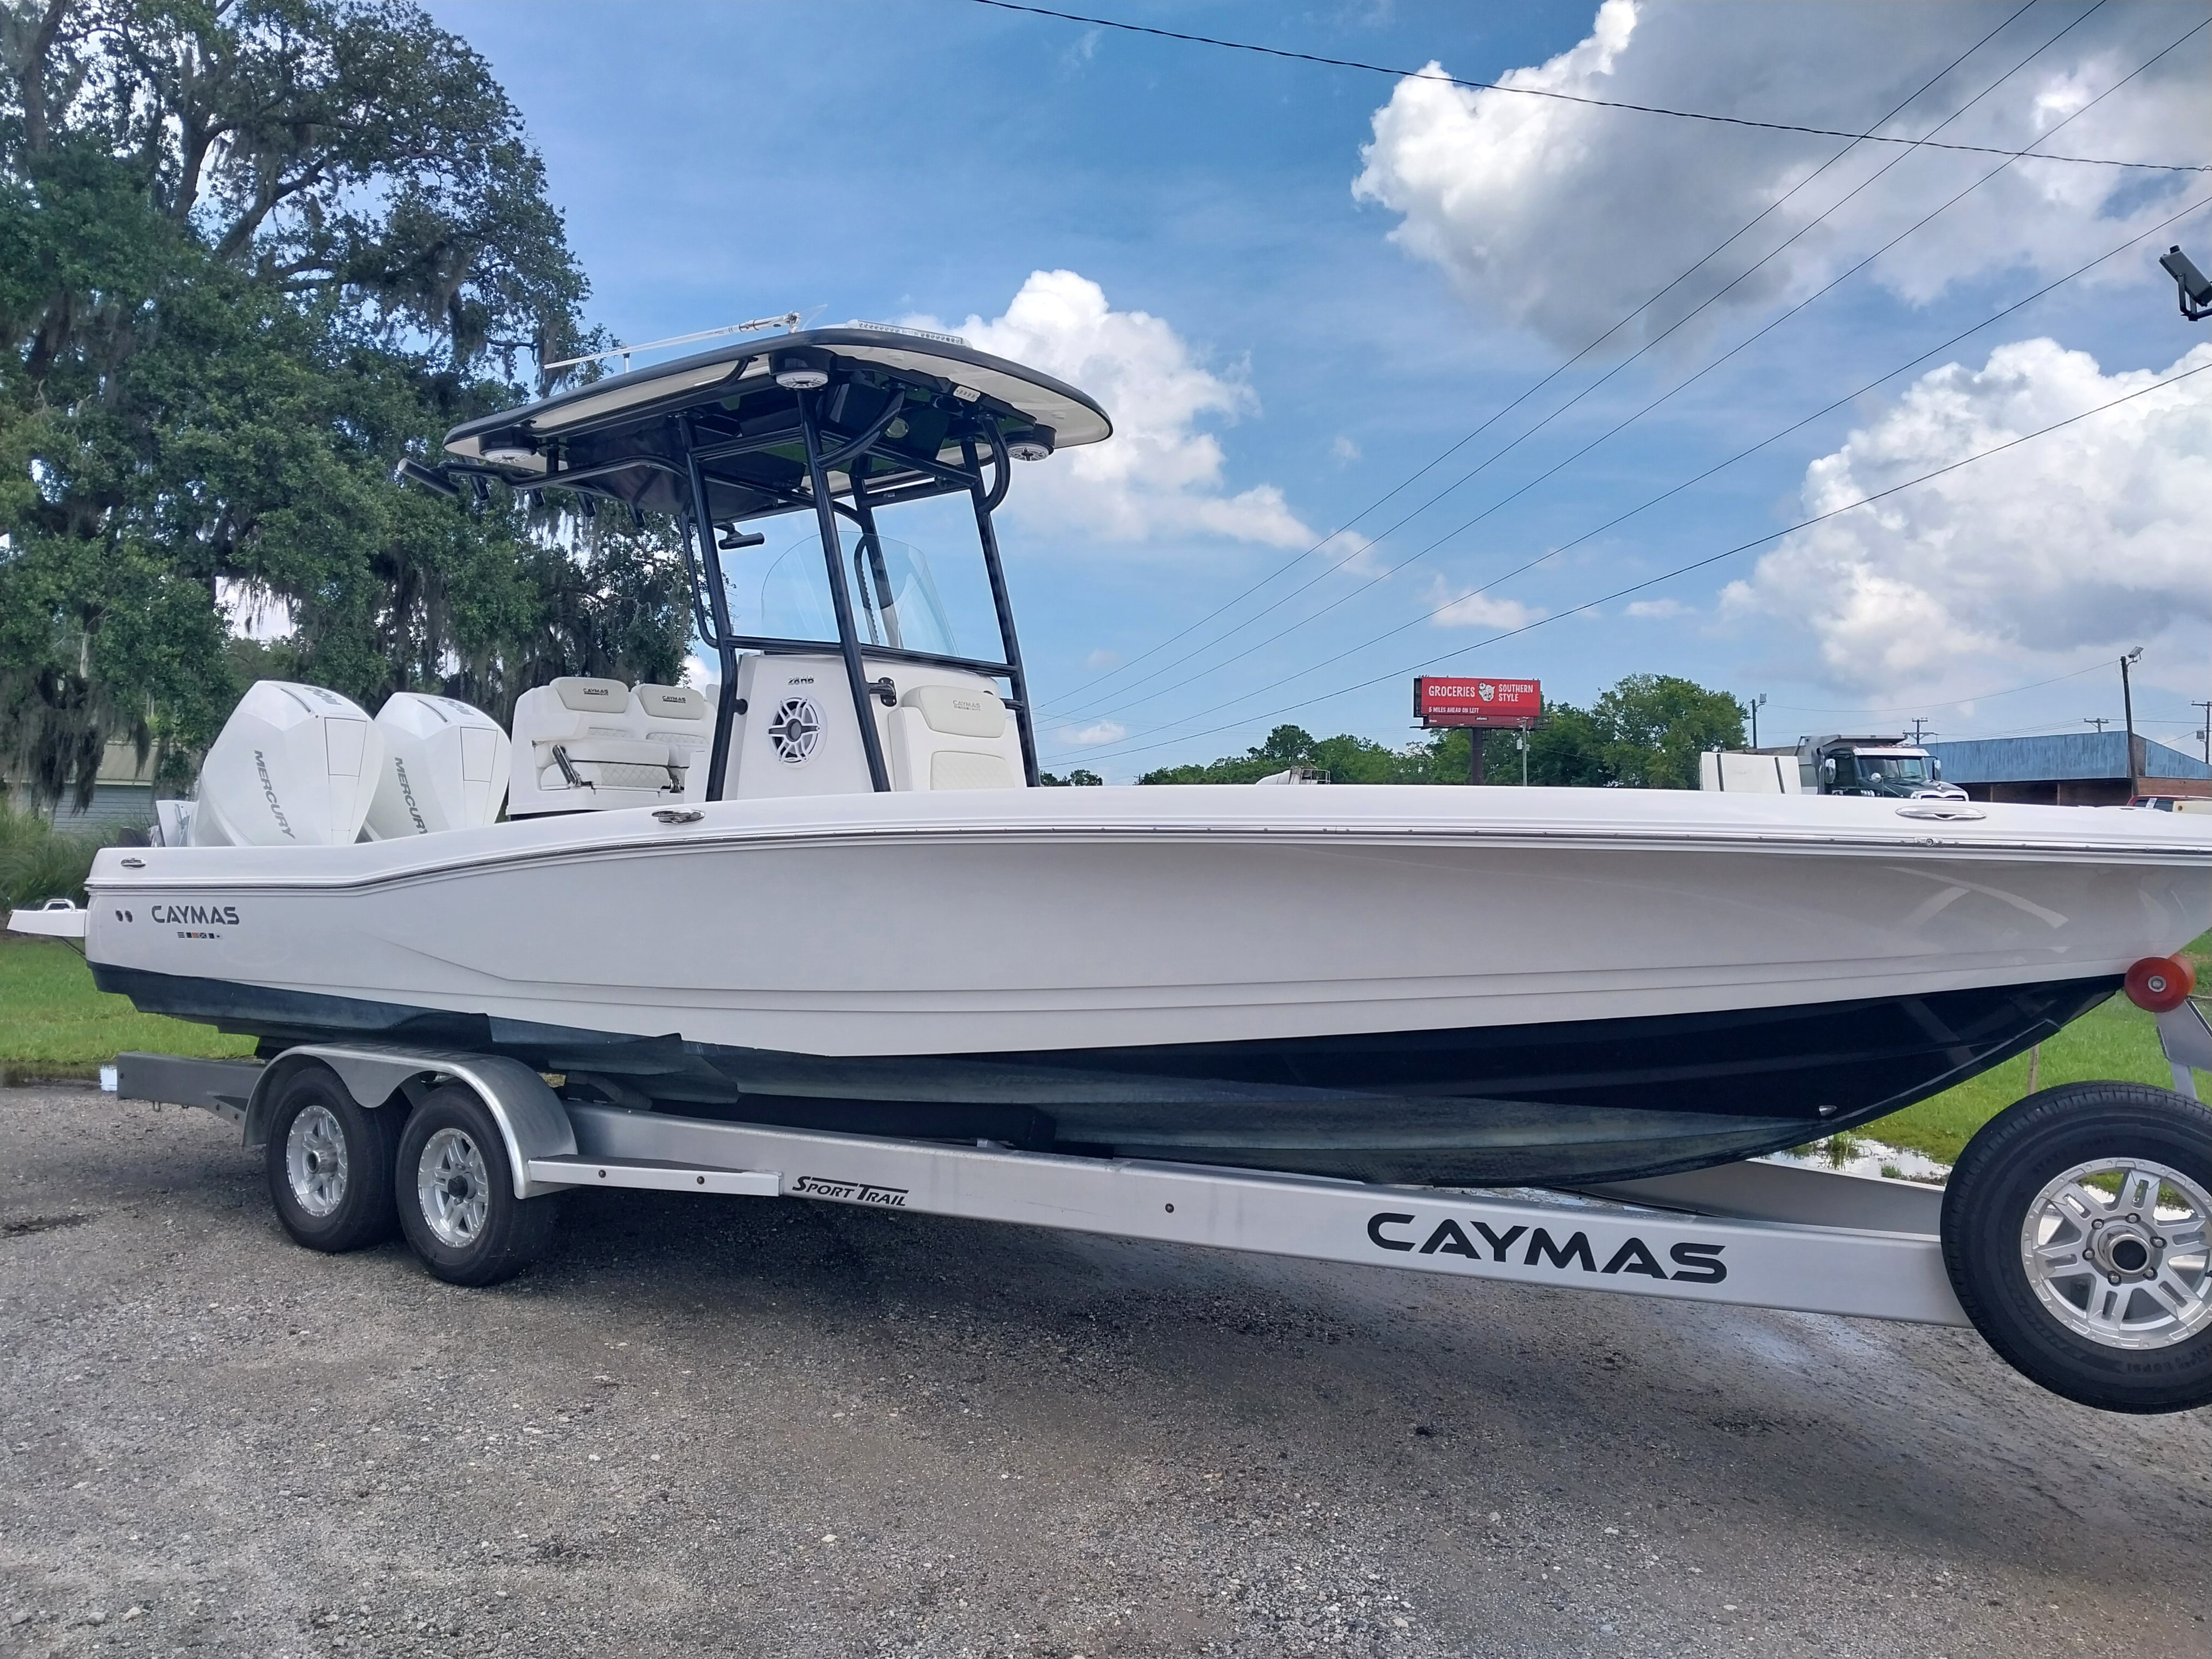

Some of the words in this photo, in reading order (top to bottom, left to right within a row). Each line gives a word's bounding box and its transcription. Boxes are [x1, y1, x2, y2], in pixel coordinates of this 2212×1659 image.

[1429, 685, 1475, 698] GROCERIES
[1499, 684, 1533, 693] SOUTHERN
[953, 700, 981, 708] CAYMAS
[1498, 693, 1519, 702] STYLE
[254, 750, 295, 839] MERCURY
[151, 905, 240, 925] CAYMAS
[792, 1176, 855, 1198] SPORT
[857, 1184, 909, 1206] TRAIL
[1367, 1212, 1727, 1284] CAYMAS
